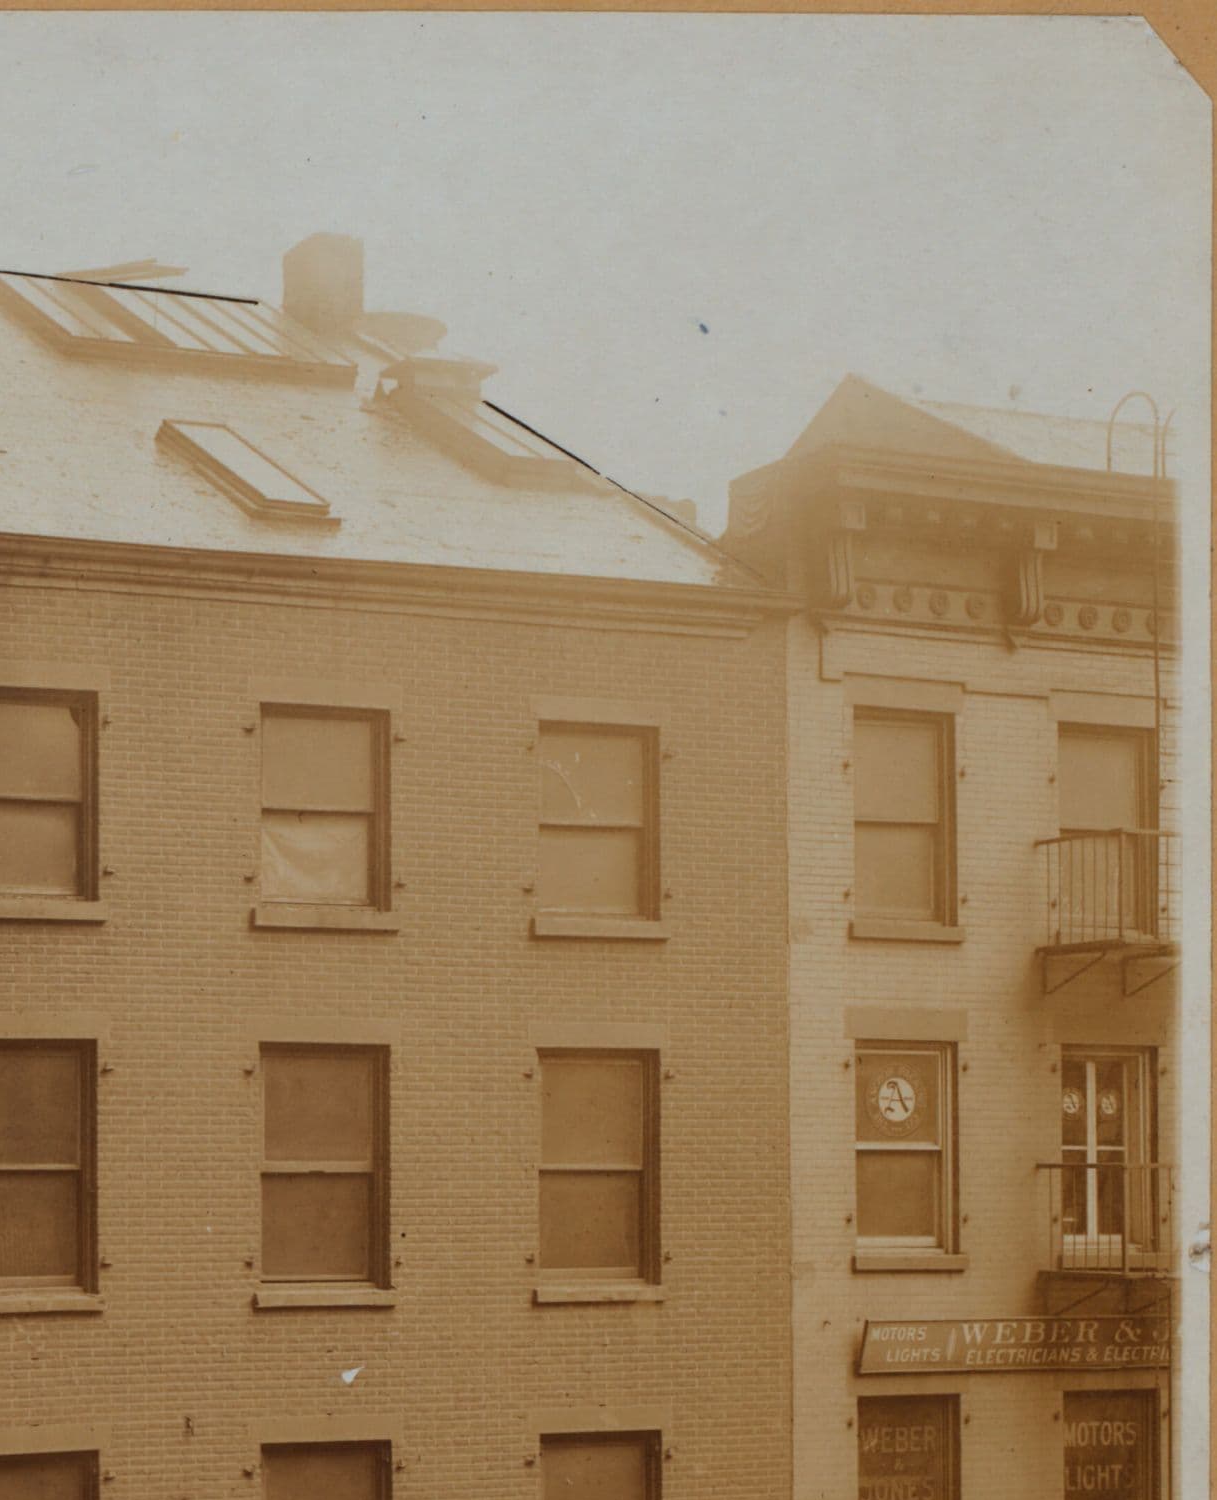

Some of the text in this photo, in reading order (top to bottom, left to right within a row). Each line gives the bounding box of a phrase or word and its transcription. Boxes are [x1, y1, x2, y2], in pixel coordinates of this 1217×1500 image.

[871, 1326, 928, 1342] MOTORS
[962, 1320, 1101, 1345] WEBER
[1115, 1319, 1142, 1342] &
[886, 1344, 1171, 1366] LIGHTS ELECTRICIANS & ELECTRI
[860, 1425, 938, 1454] WEBER
[1064, 1421, 1138, 1448] MOTORS
[1064, 1464, 1135, 1492] LIGHTS
